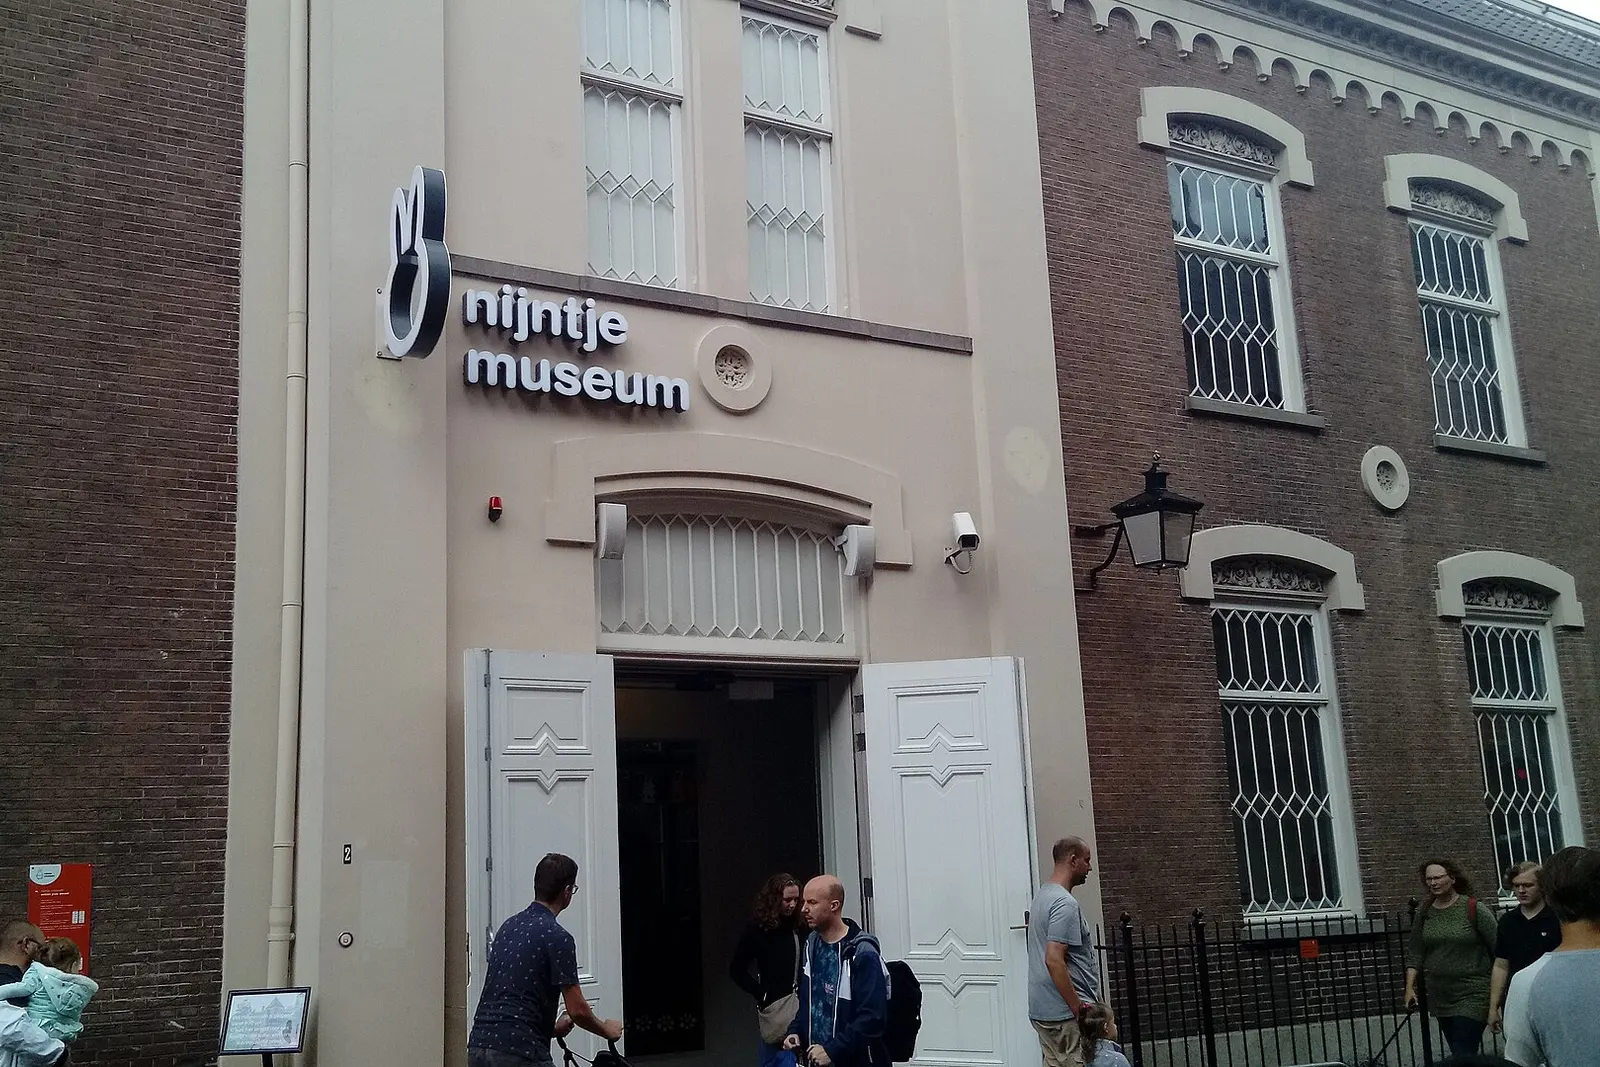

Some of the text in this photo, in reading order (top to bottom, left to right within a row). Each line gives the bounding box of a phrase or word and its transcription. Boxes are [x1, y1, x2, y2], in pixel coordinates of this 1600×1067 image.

[463, 284, 629, 353] nijntje
[465, 349, 690, 412] museum
[344, 846, 351, 861] 2
